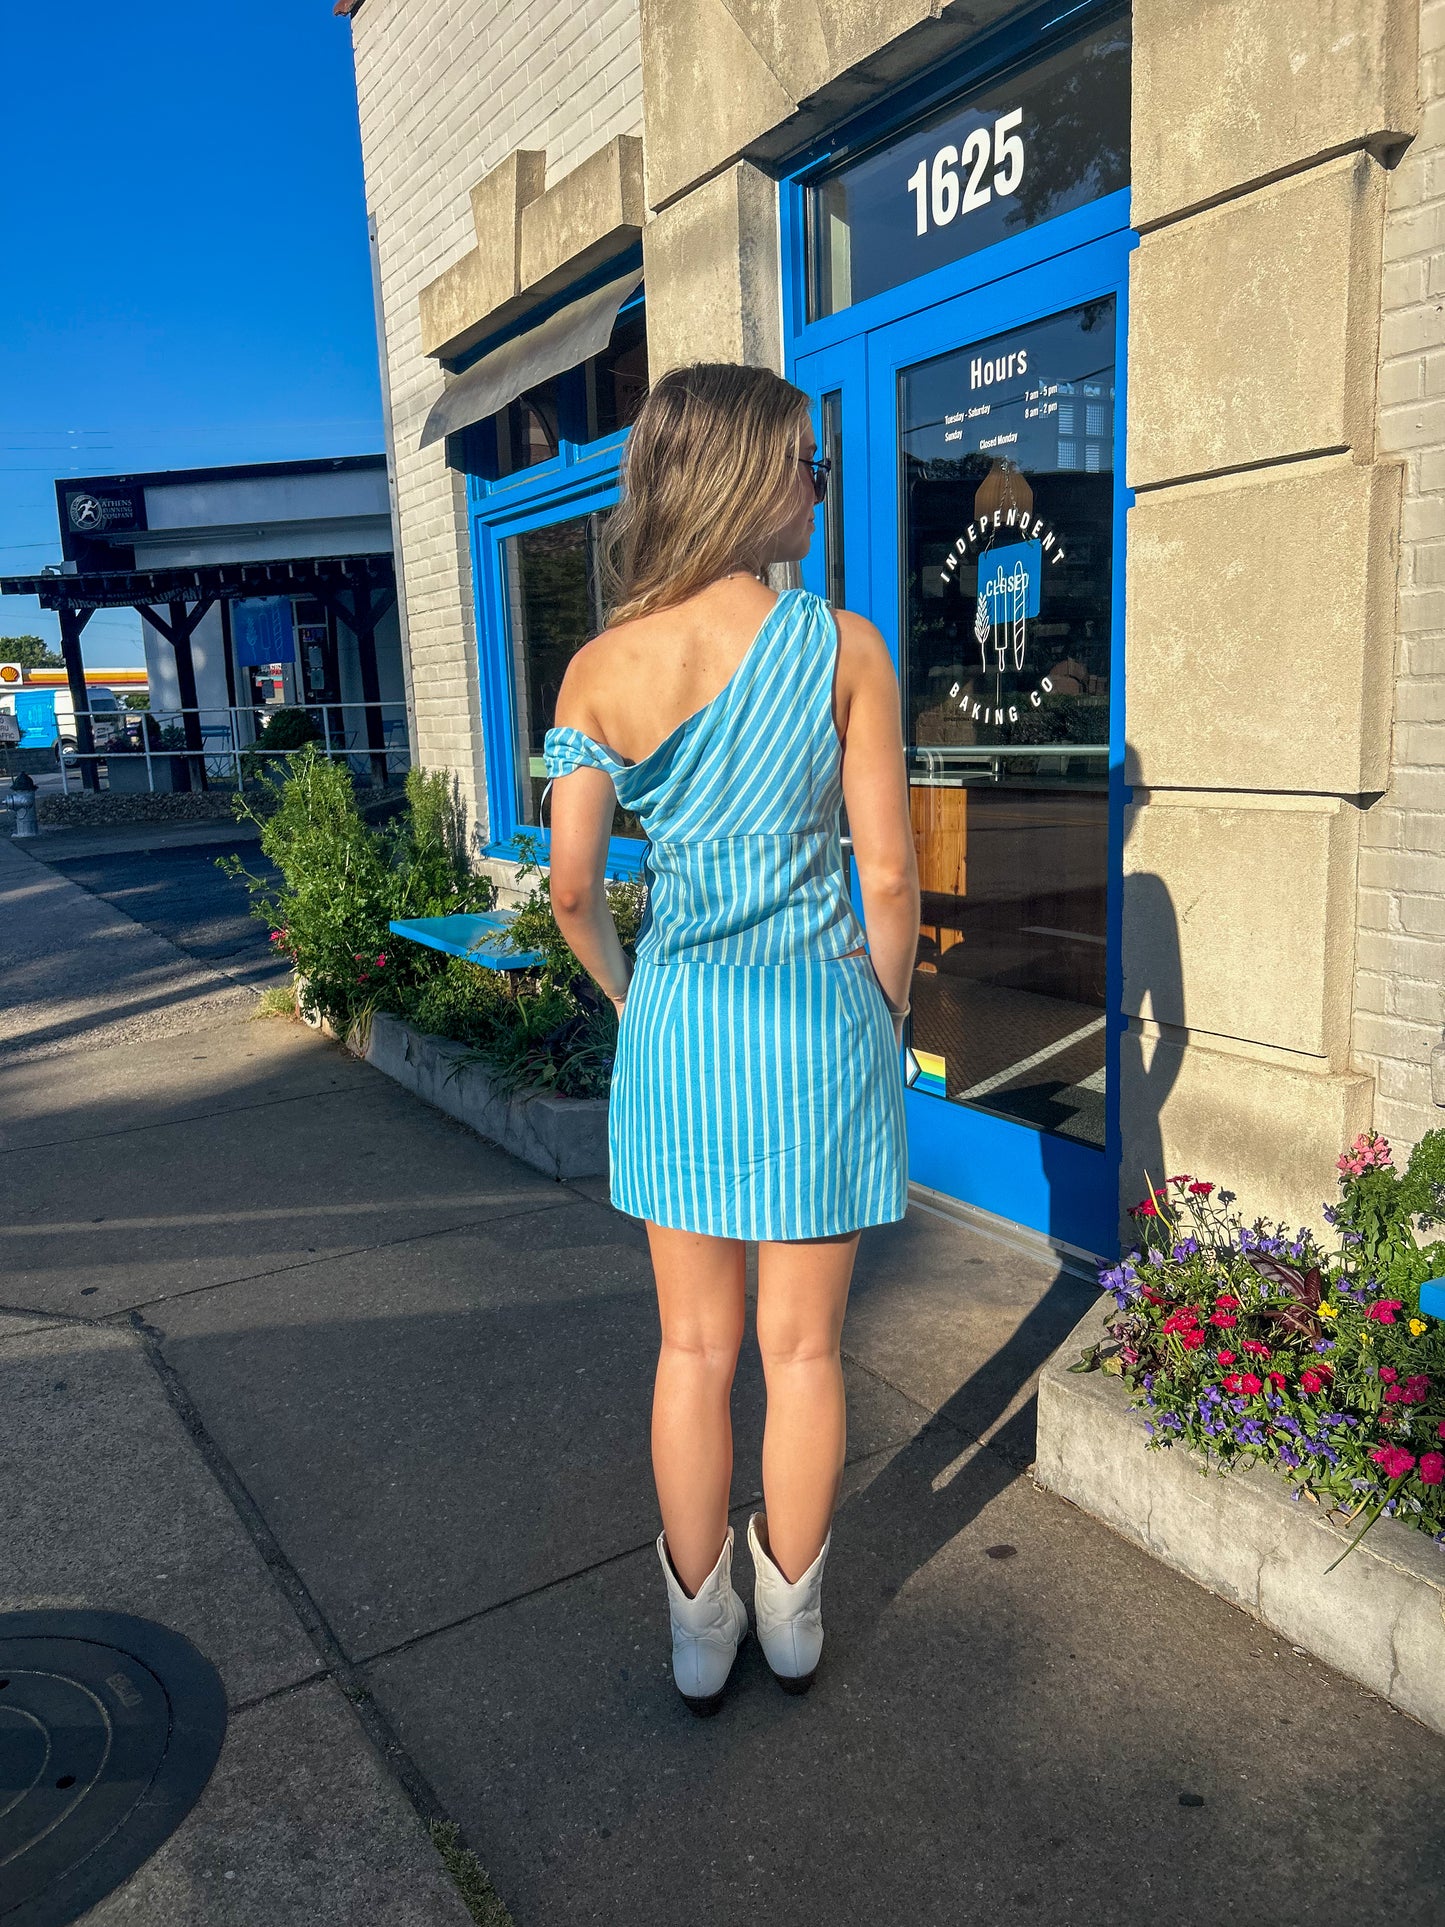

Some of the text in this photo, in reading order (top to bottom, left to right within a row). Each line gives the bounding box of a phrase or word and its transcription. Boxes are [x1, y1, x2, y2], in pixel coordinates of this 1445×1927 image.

[907, 106, 1025, 237] 1625
[970, 349, 1028, 390] Hours
[944, 411, 965, 425] Tuesday
[967, 404, 991, 419] Saturday
[1025, 391, 1029, 401] 7
[1029, 390, 1039, 400] am
[1043, 385, 1048, 396] 5
[1048, 384, 1058, 397] pm
[944, 429, 963, 442] Sunday
[1024, 408, 1029, 419] 8
[1029, 407, 1039, 417] am
[1043, 403, 1048, 413] 2
[1048, 402, 1058, 415] pm
[979, 431, 1018, 450] Closed Monday
[101, 499, 132, 508] ATHENS
[102, 512, 133, 520] COMPANY
[940, 508, 1065, 583] INDEPENDENT
[985, 571, 1030, 597] CLOSED
[949, 676, 1053, 725] BAKING CO
